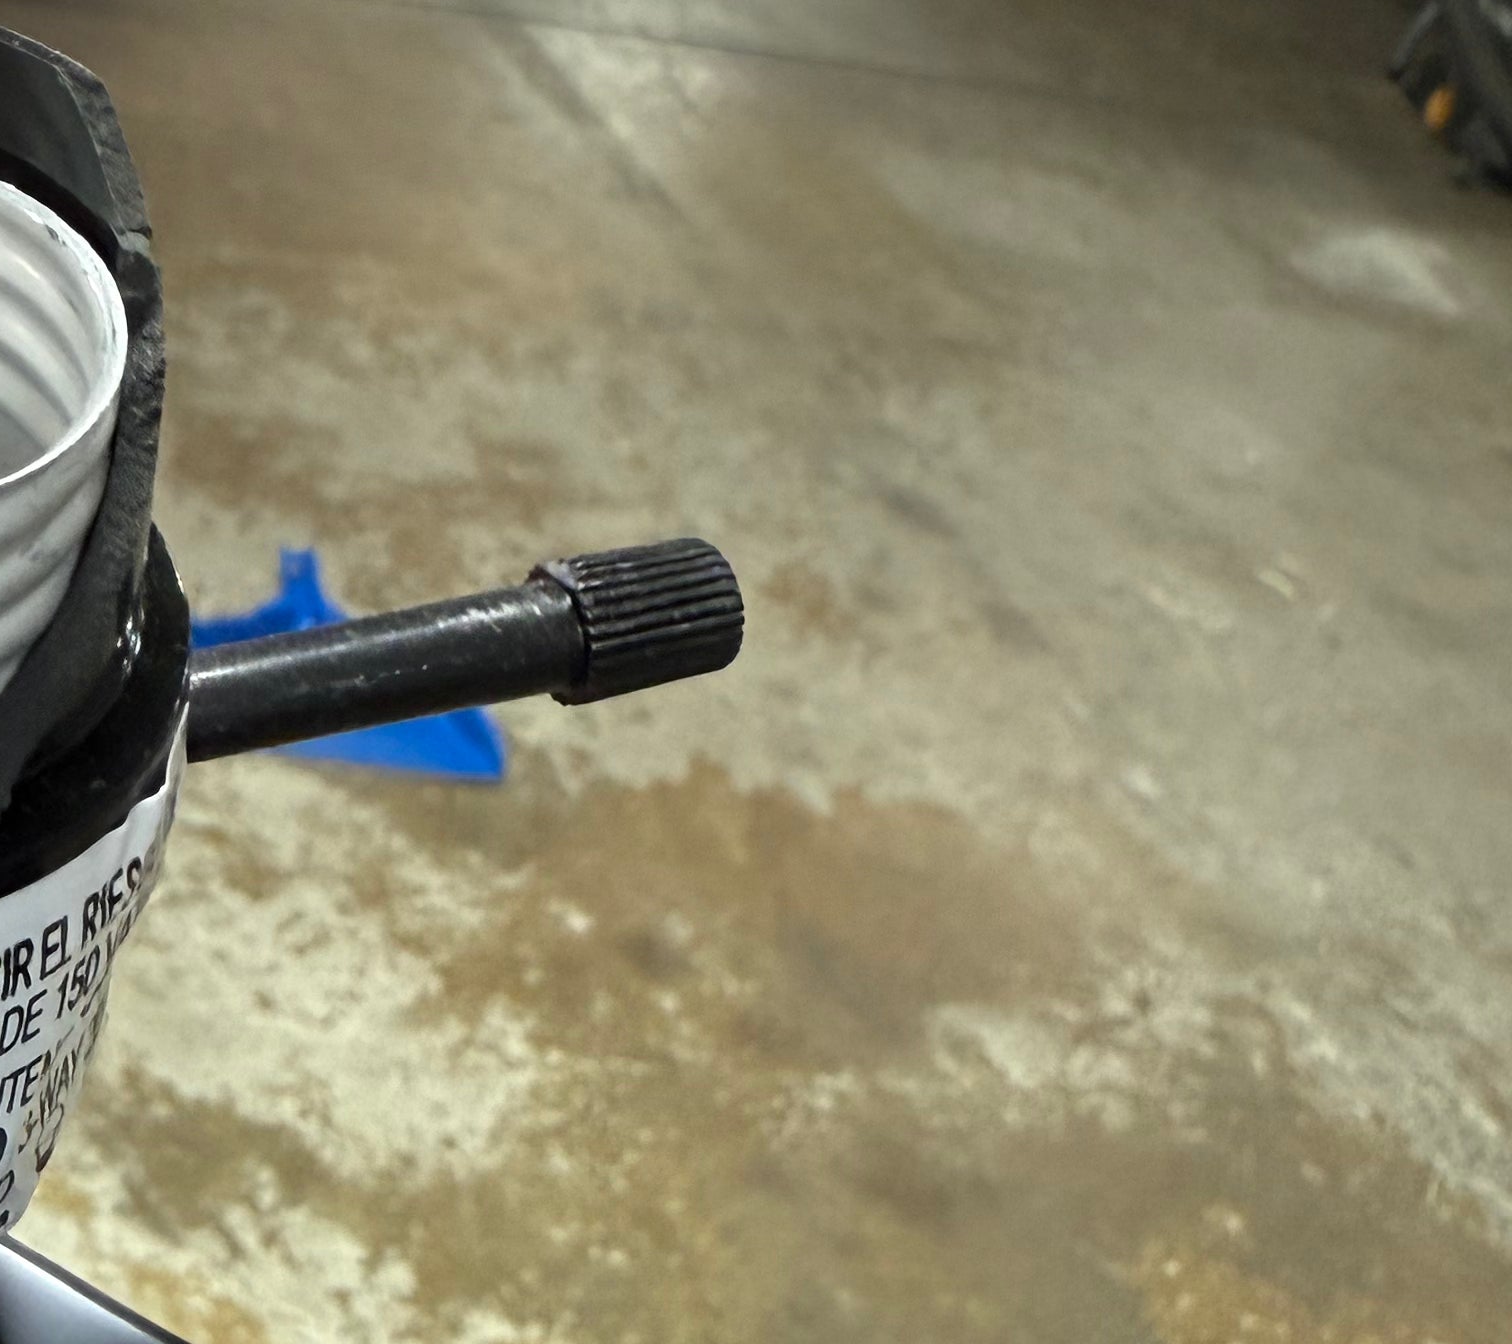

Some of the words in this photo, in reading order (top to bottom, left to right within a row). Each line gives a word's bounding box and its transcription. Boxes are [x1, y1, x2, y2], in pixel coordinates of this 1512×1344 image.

[39, 915, 71, 980] EL
[81, 856, 142, 952] RIES
[55, 945, 101, 1020] 150
